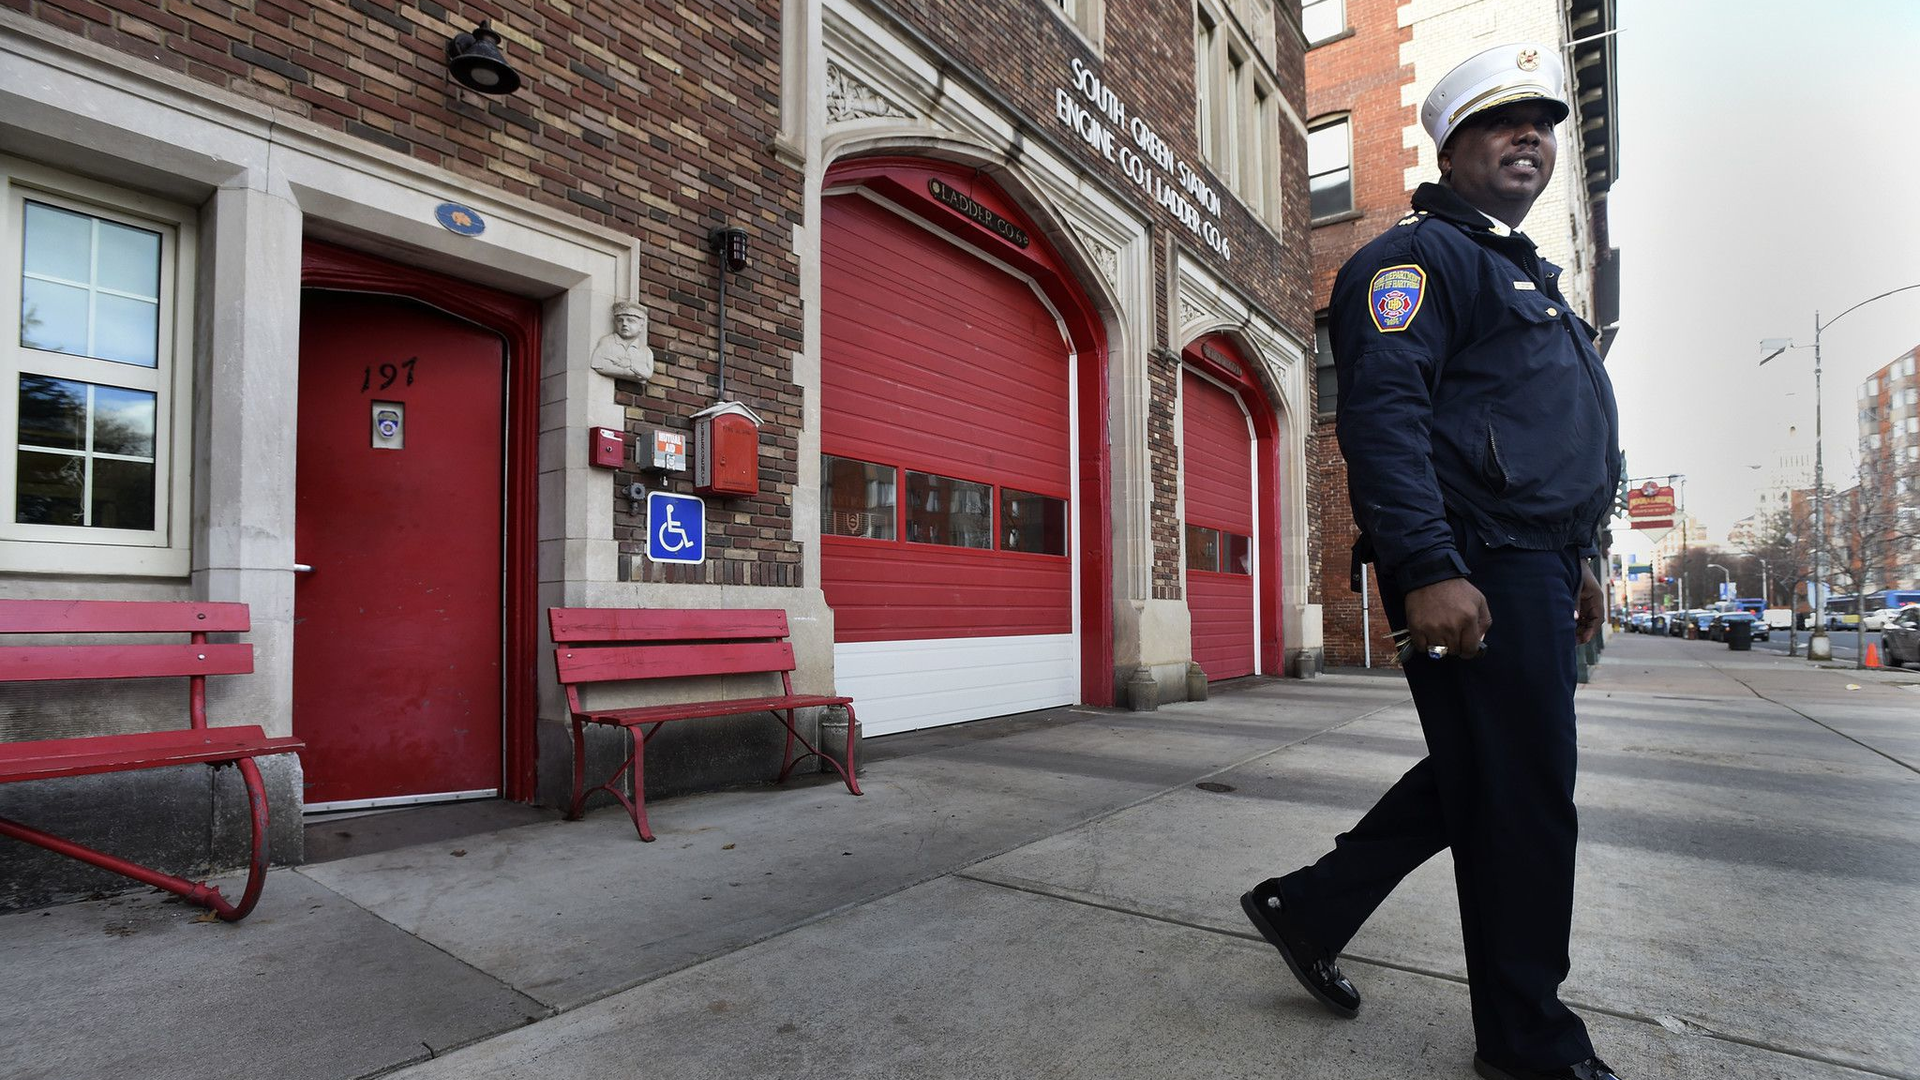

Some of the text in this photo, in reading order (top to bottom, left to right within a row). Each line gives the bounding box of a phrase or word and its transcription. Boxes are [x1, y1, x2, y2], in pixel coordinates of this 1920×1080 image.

[1056, 88, 1116, 163] ENGINE
[1156, 177, 1201, 237] LADDER
[1071, 57, 1221, 219] SOUTH GREEN STATION
[941, 184, 993, 227] LADDER
[361, 356, 418, 394] 197
